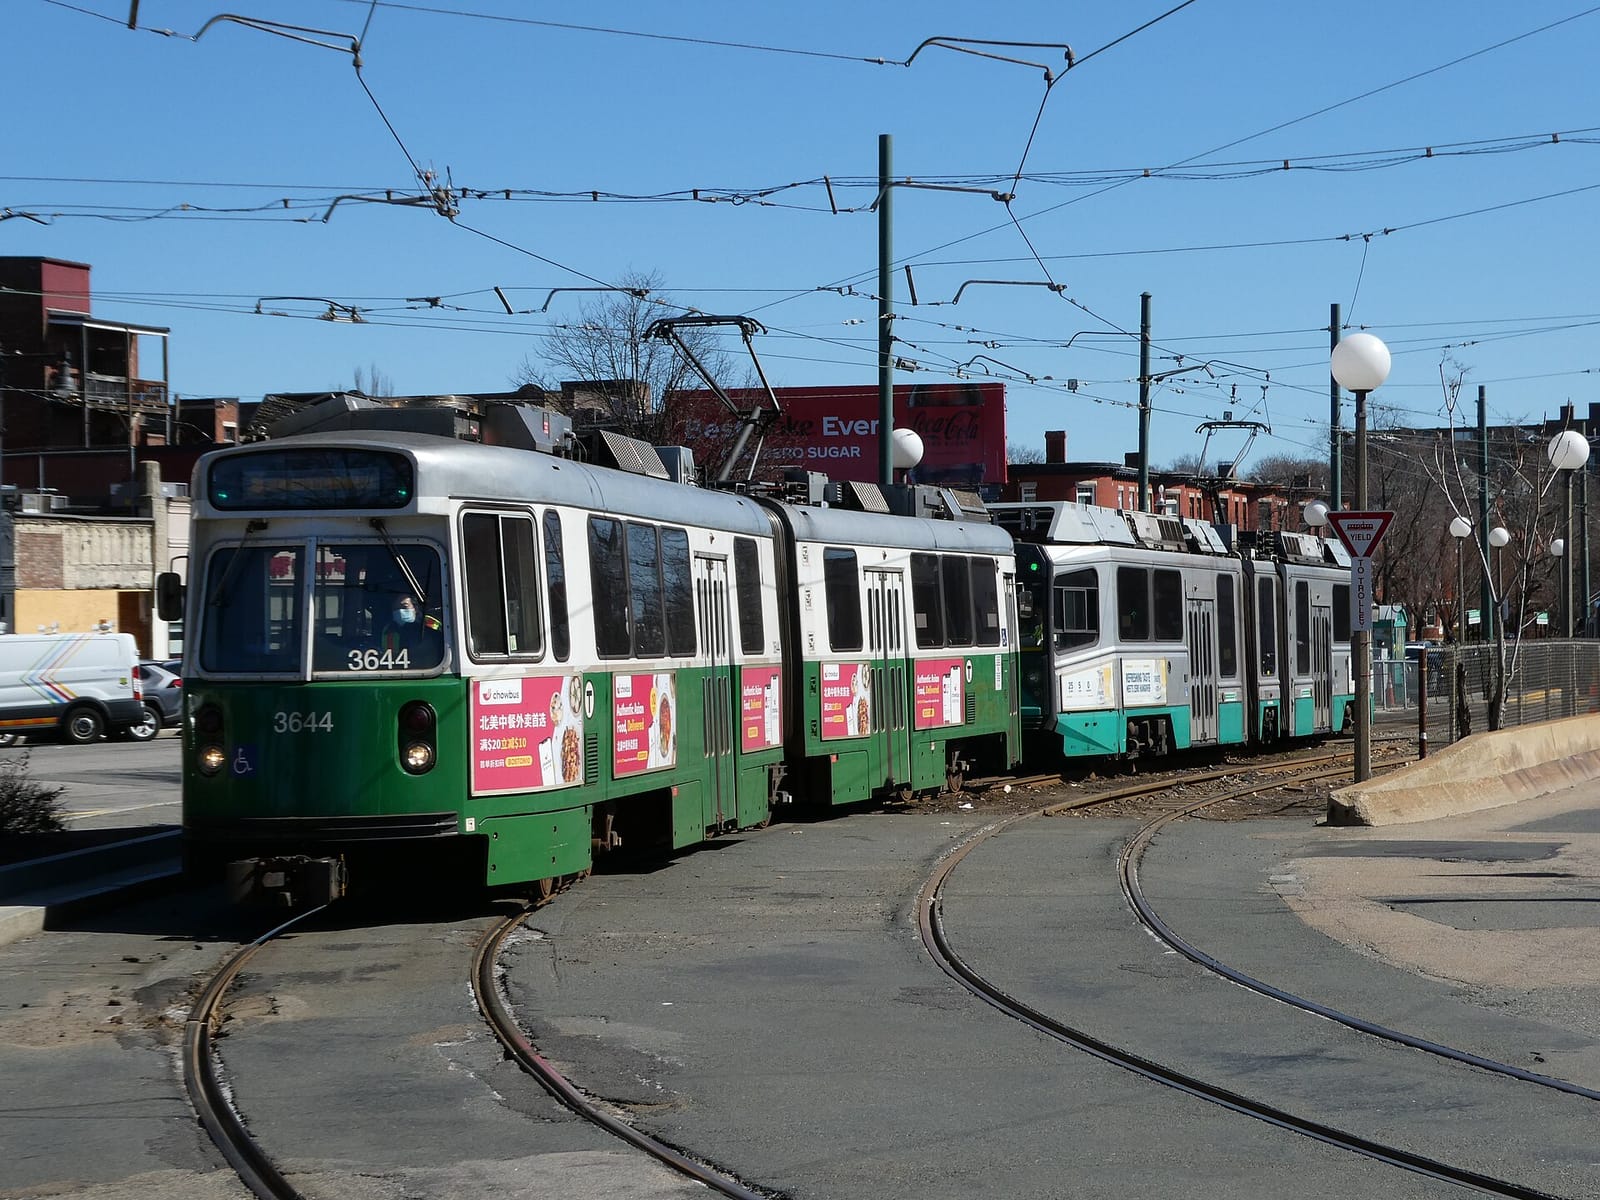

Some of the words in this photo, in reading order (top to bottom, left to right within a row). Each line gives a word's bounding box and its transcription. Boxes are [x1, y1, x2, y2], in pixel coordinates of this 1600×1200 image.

[823, 415, 889, 437] Ever
[807, 446, 861, 459] SUGAR
[1350, 533, 1372, 541] YIELD
[1357, 559, 1365, 574] TO
[347, 648, 411, 671] 3644
[492, 688, 520, 700] chowbus
[273, 711, 334, 733] 3644
